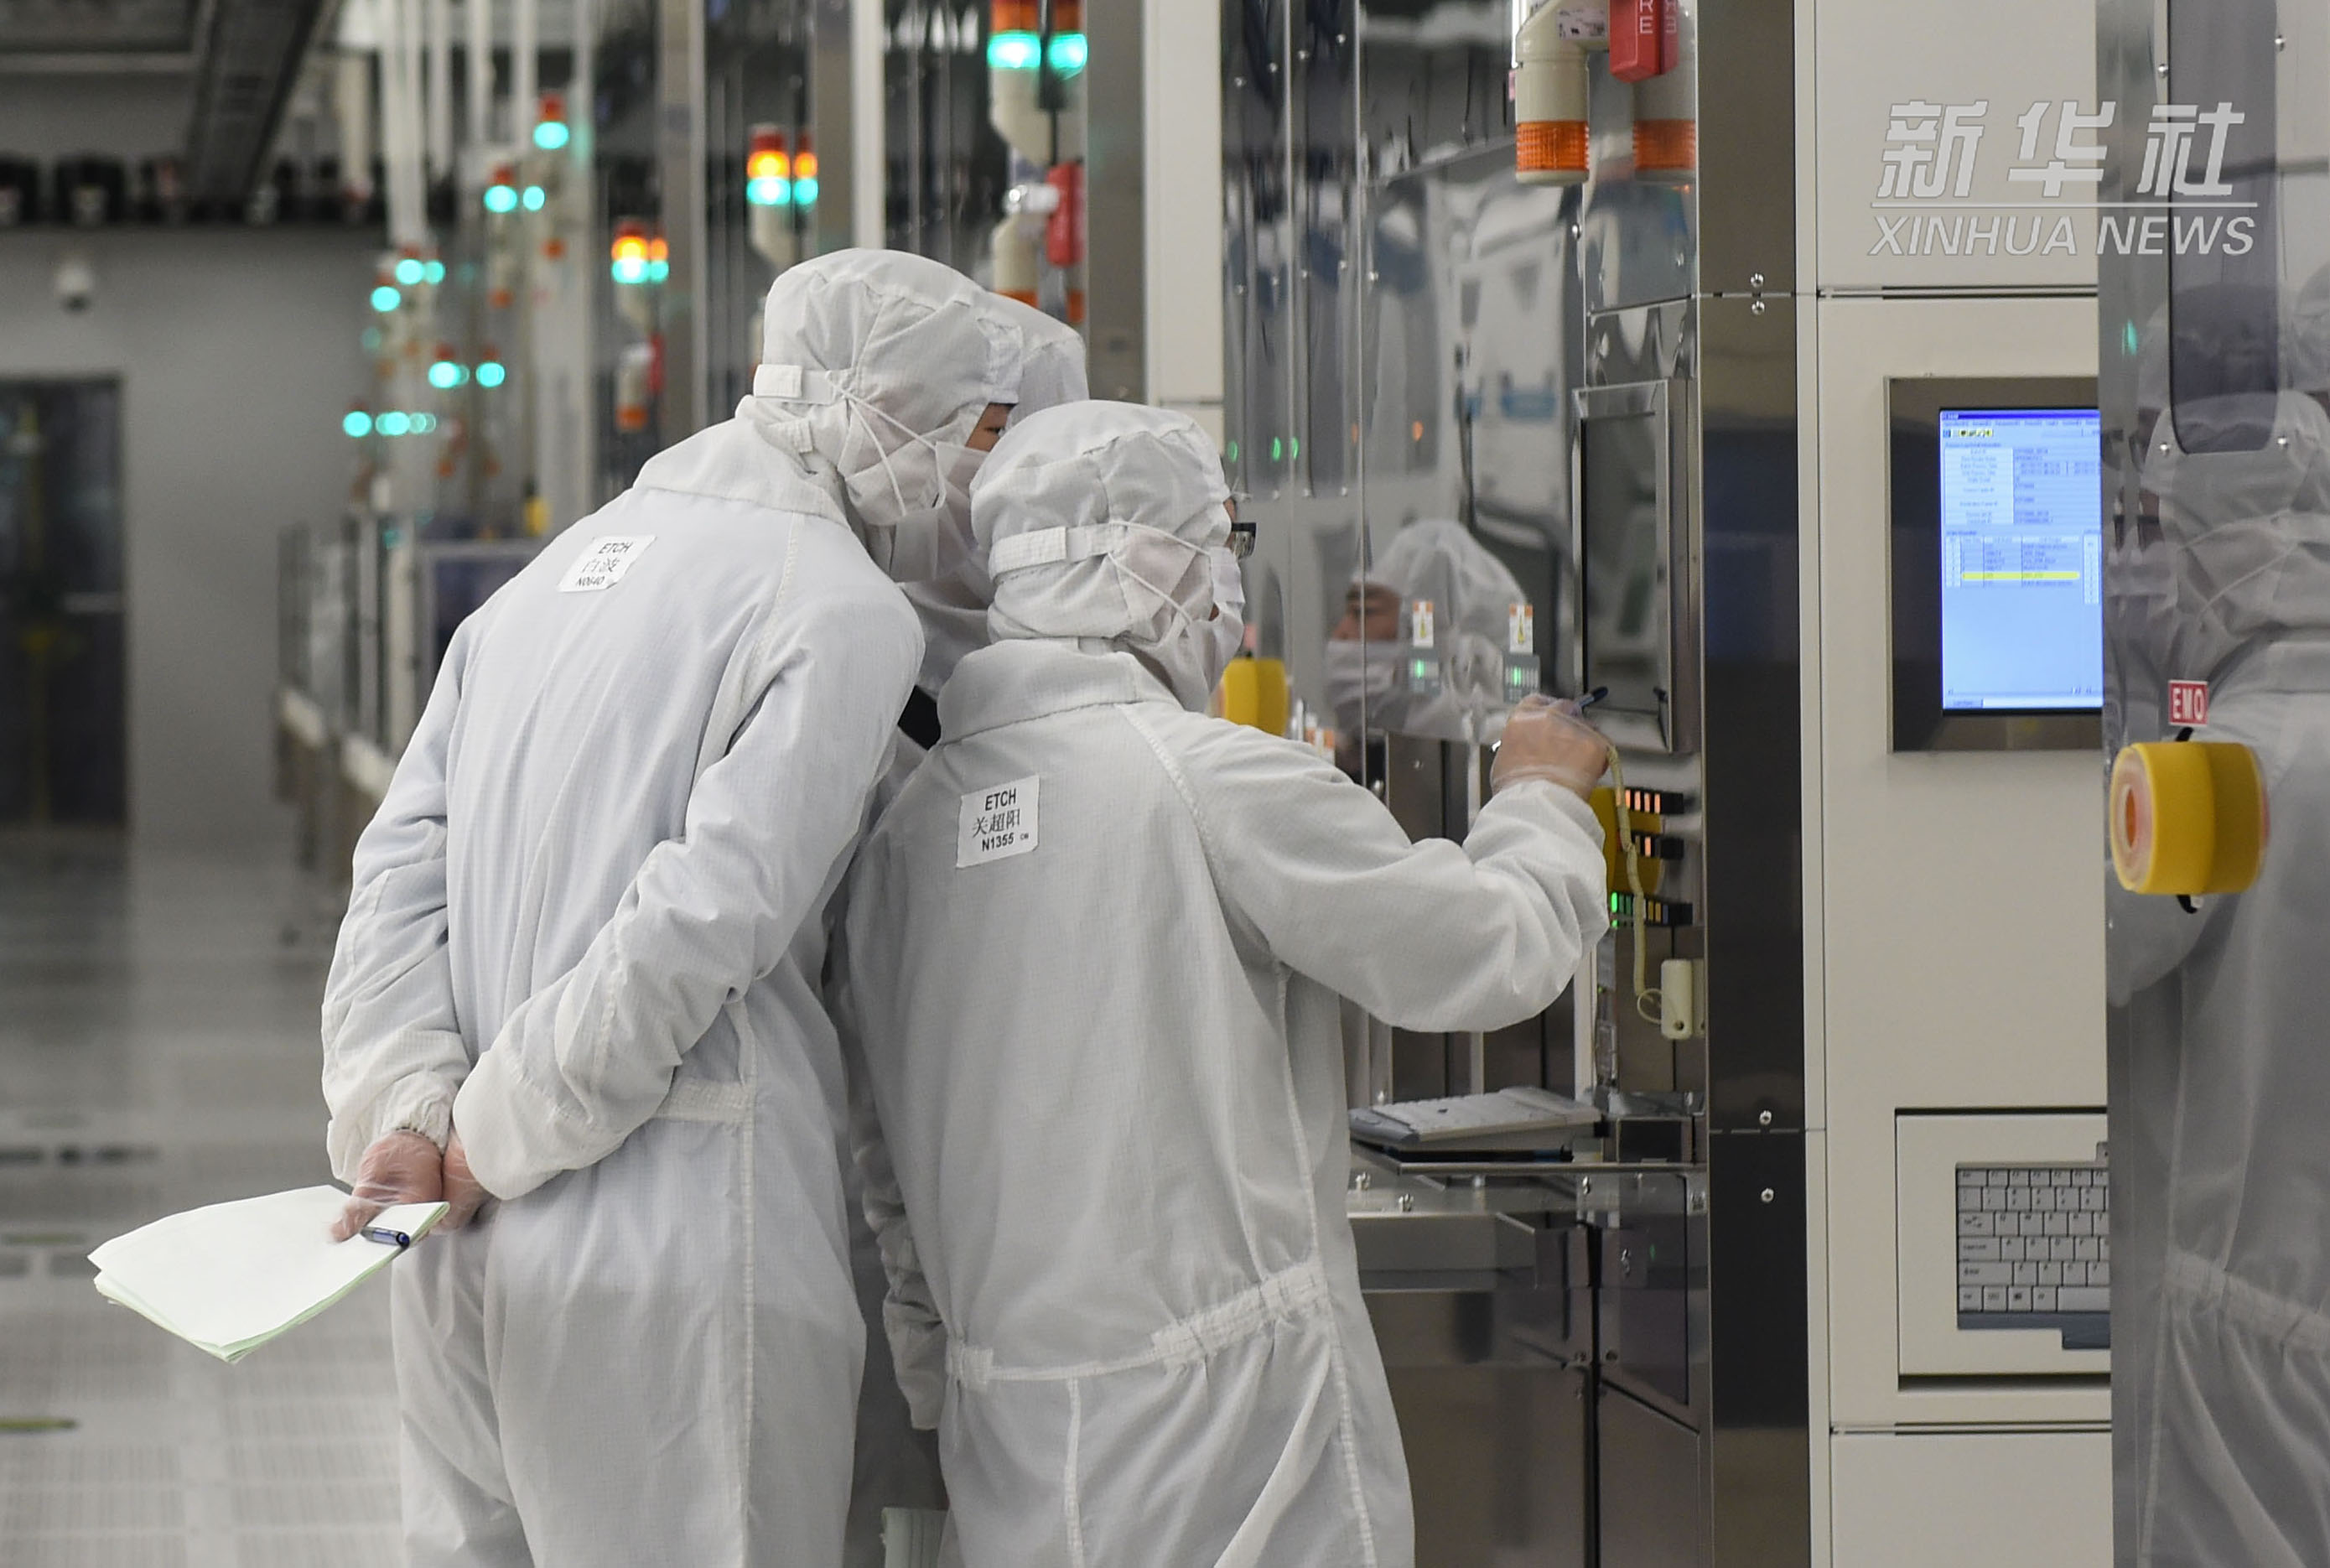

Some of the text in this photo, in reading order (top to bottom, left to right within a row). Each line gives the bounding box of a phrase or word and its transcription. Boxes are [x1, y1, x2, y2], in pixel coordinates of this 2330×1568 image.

[598, 542, 634, 554] ETCH
[2172, 688, 2206, 720] EMO
[984, 787, 1017, 812] ETCH
[981, 832, 1015, 853] N1355
